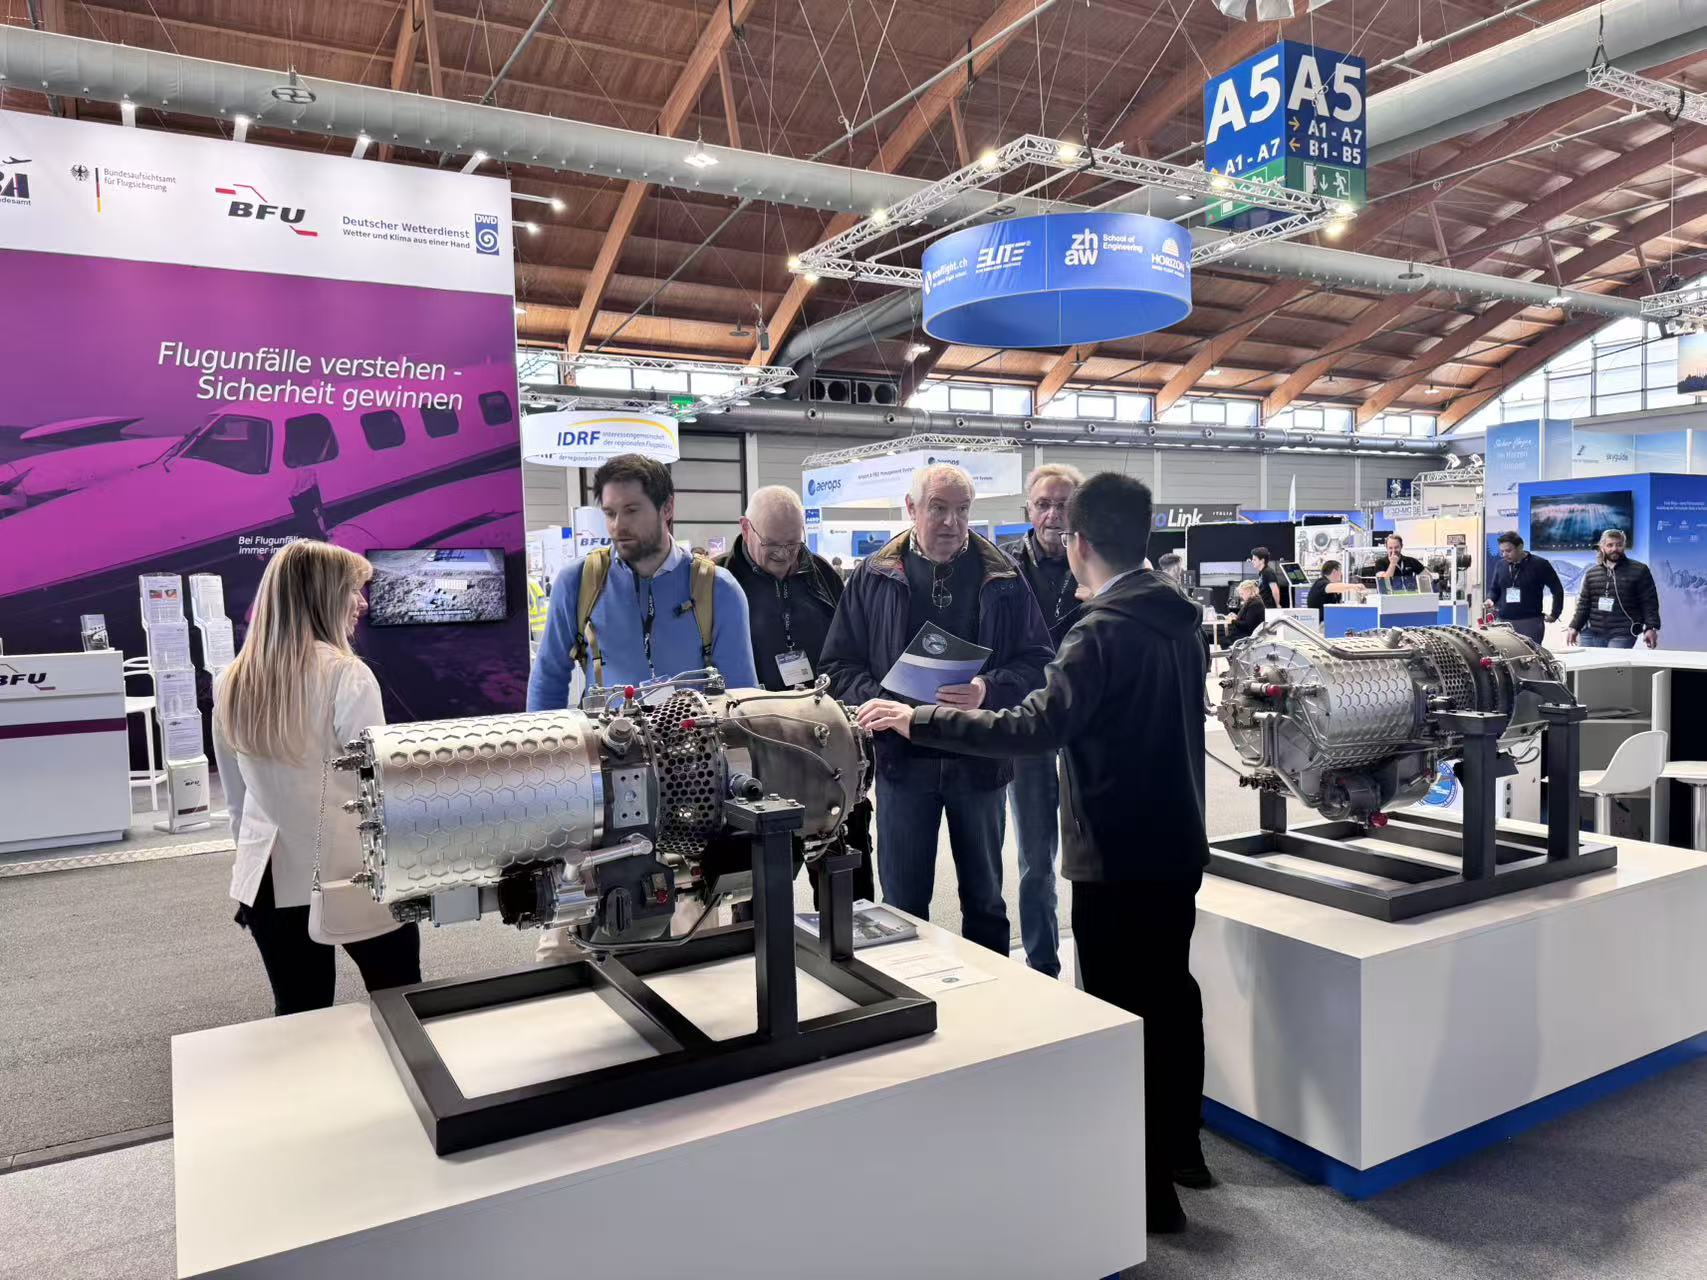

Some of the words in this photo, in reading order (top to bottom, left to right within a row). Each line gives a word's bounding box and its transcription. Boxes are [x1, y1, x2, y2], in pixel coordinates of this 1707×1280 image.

[1287, 54, 1362, 123] A5
[1206, 54, 1281, 145] A5
[1308, 120, 1327, 138] A1
[1341, 127, 1362, 145] A7
[1224, 153, 1243, 176] A1
[1257, 137, 1280, 163] A7
[1309, 140, 1328, 159] B1
[1342, 148, 1362, 165] B5
[104, 168, 177, 184] Bundesaufsichtsamt
[104, 177, 116, 186] für
[117, 178, 168, 193] Flugsicherung
[0, 197, 31, 206] desamt
[227, 200, 306, 224] BFU
[342, 215, 399, 231] Deutscher
[401, 222, 470, 239] Wetterdienst
[475, 214, 498, 225] DWD
[342, 229, 371, 239] Wetter
[372, 231, 388, 241] und
[389, 233, 412, 243] Klima
[413, 236, 428, 245] aus
[428, 238, 448, 247] einer
[450, 239, 470, 250] Hand
[1071, 227, 1098, 250] zh
[1102, 233, 1127, 244] School
[1127, 234, 1136, 243] of
[1102, 241, 1144, 254] Engineering
[1064, 248, 1098, 266] aw
[1151, 252, 1185, 273] HORIZON
[158, 341, 312, 373] Flugunfälle
[321, 356, 445, 380] verstehen
[196, 376, 336, 405] Sicherheit
[342, 386, 463, 411] gewinnen
[557, 431, 600, 447] IDRF
[816, 479, 842, 493] aerops
[1151, 507, 1203, 528] oLink
[238, 535, 254, 546] Bei
[238, 545, 270, 556] immer
[580, 537, 612, 547] BFU
